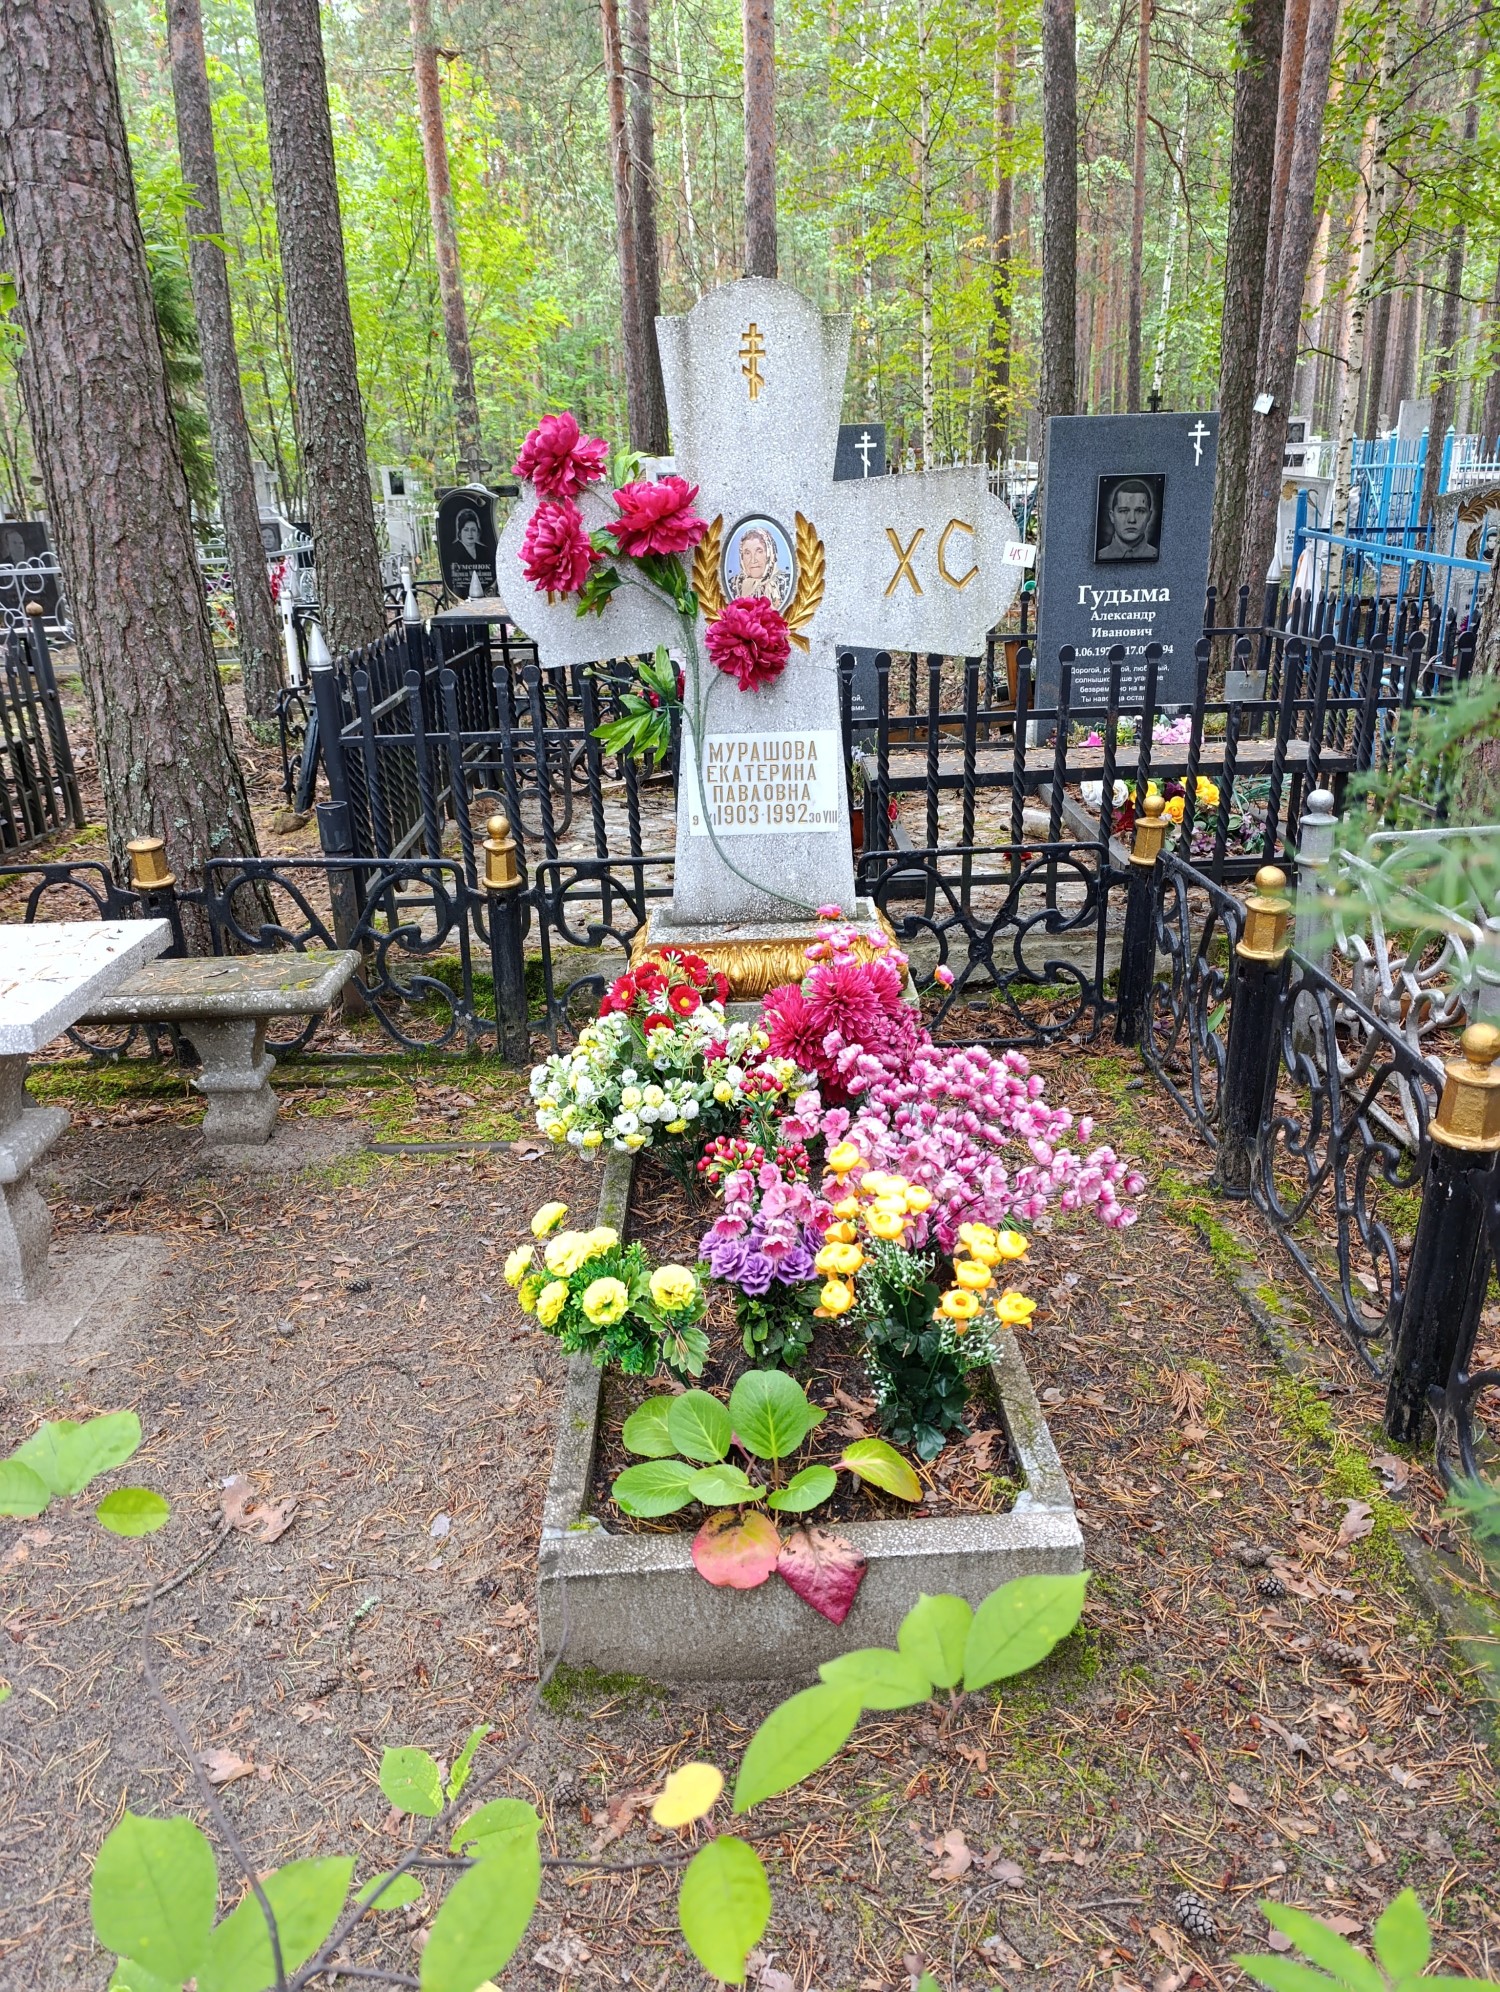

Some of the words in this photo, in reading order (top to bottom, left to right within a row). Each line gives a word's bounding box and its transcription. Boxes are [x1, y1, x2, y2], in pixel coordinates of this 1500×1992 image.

[1009, 546, 1029, 561] 451
[1077, 585, 1171, 610] Гудыма
[1090, 611, 1156, 622] Александр
[1091, 627, 1153, 638] Иванович
[1133, 664, 1170, 673] любый,
[1081, 695, 1092, 703] Ты
[708, 740, 818, 763] МУРАШОВА
[706, 764, 817, 783] ЕКАТЕРИНА
[713, 783, 811, 803] ПАВЛОВНА
[692, 815, 699, 826] 9
[717, 804, 759, 826] 1903
[767, 803, 809, 825] 1992
[808, 812, 822, 823] 30
[822, 810, 838, 824] VIII
